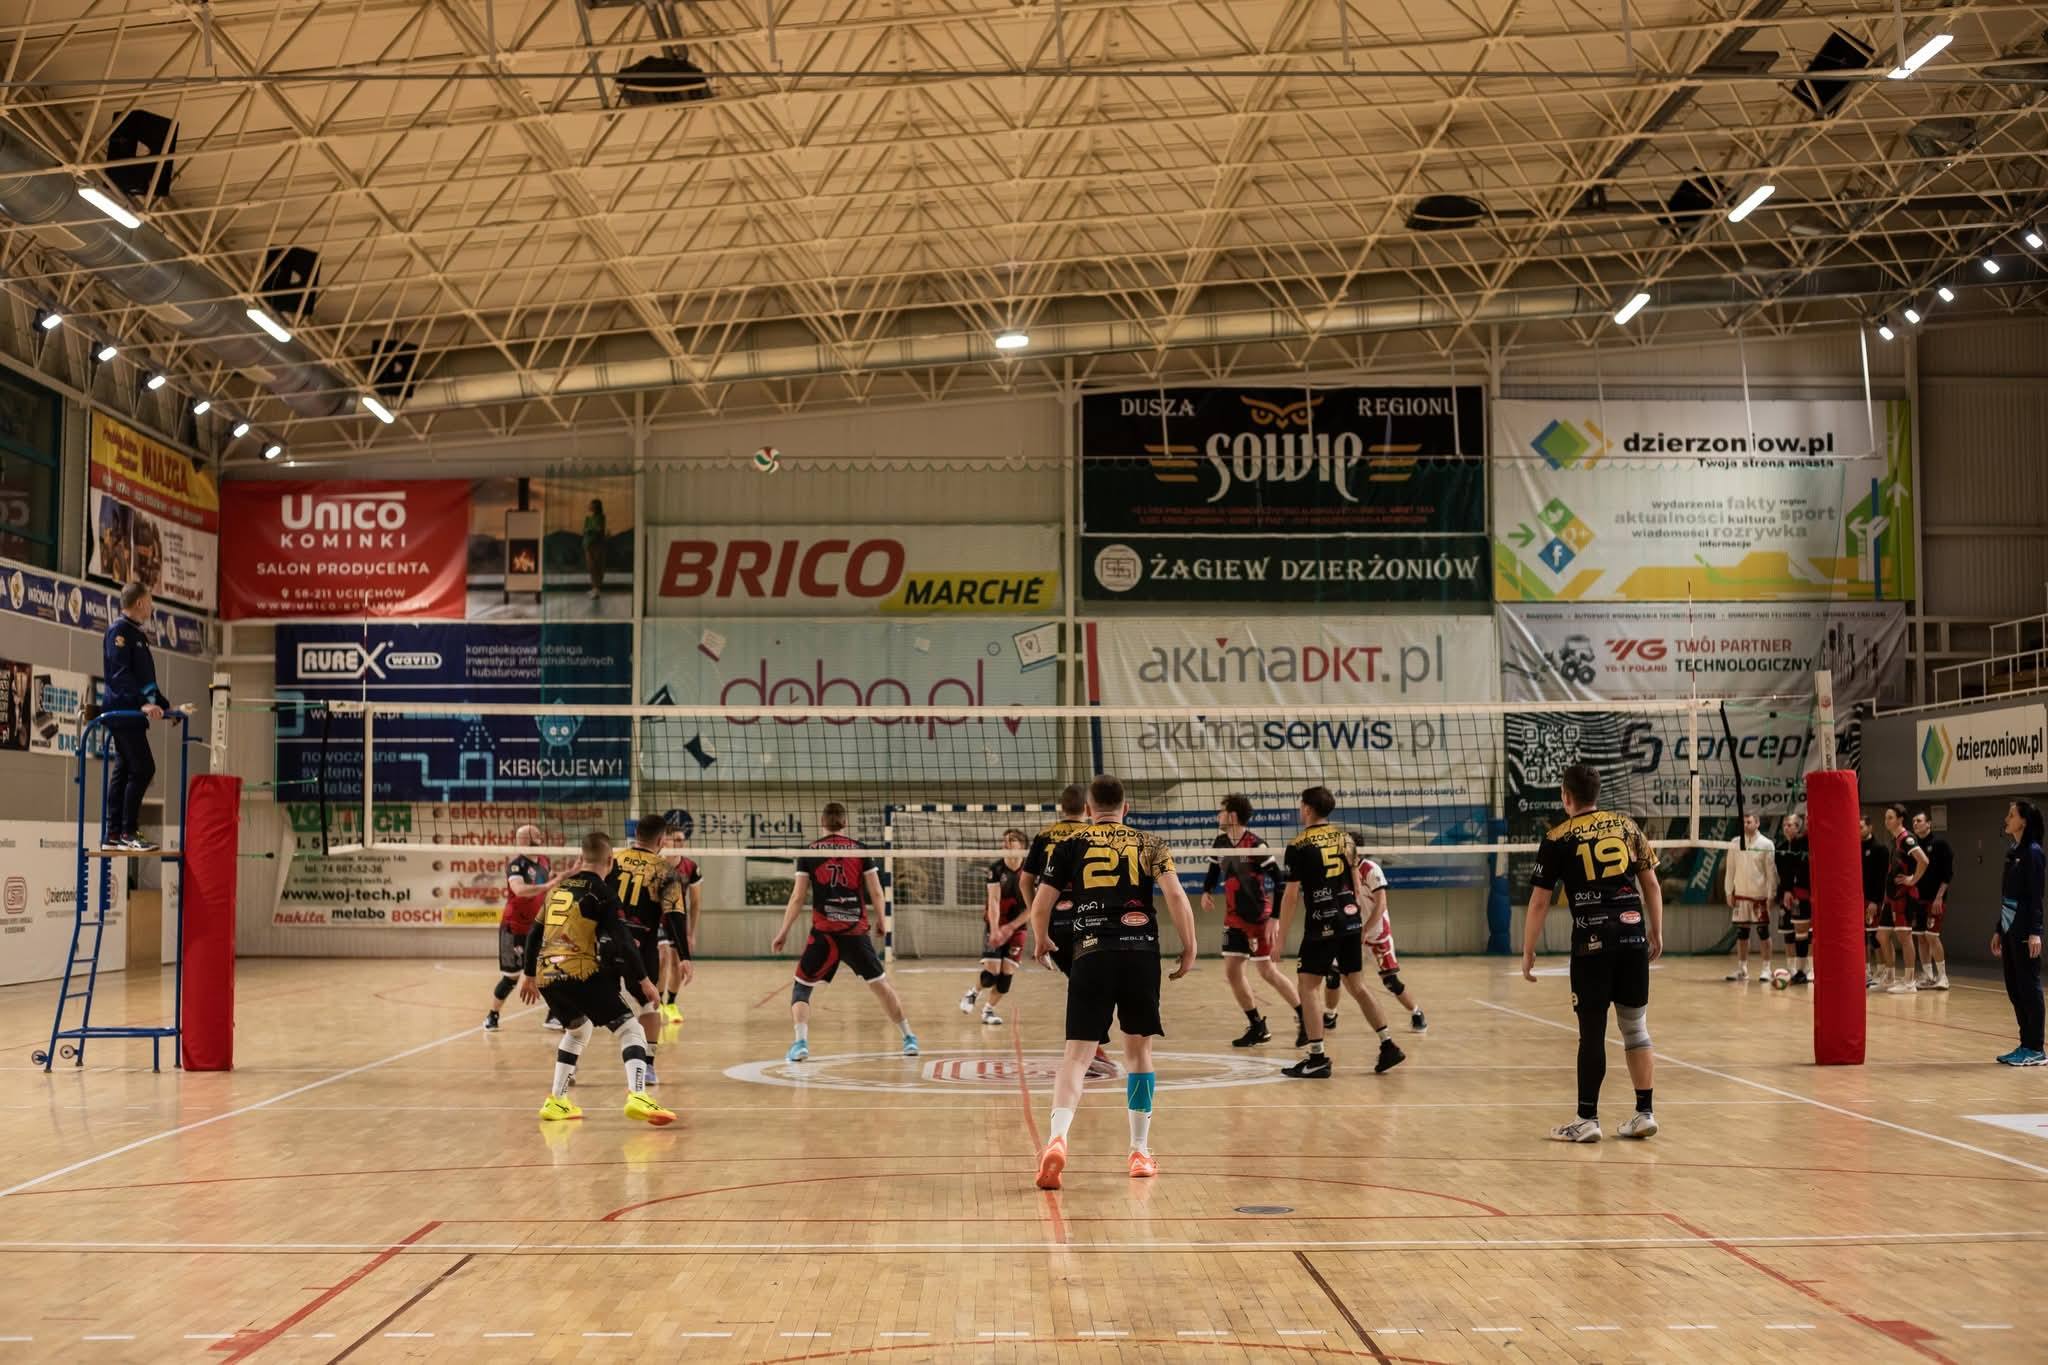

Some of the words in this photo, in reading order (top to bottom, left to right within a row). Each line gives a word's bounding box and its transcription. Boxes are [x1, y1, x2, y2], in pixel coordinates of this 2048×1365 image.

[1120, 398, 1195, 417] DUSZA
[1623, 432, 1834, 457] dzierzoniow.pl
[1727, 496, 1777, 512] fakty
[1727, 514, 1776, 525] kultura
[1780, 506, 1836, 523] sport
[280, 533, 406, 548] KOMINKI
[1712, 524, 1808, 541] rozrywka
[256, 562, 311, 576] SALON
[316, 560, 431, 576] PRODUCENTA
[658, 538, 906, 599] BRICO
[1150, 552, 1272, 581] ŻAGIEW
[1281, 552, 1481, 581] DZIERŻONIÓW
[904, 576, 1044, 605] MARCHÉ
[1674, 635, 1716, 654] TWÓJ
[1721, 638, 1792, 652] PARTNER
[1674, 657, 1814, 672] TECHNOLOGICZNY
[720, 658, 984, 741] doba.pl
[1956, 727, 2044, 761] dzierzoniow.pl
[498, 758, 623, 777] KIBICUJEMY!
[1985, 765, 2000, 780] Twoja
[2002, 764, 2021, 776] strona
[2022, 763, 2044, 775] miasta
[1652, 790, 1682, 805] dla
[1083, 845, 1140, 889] 21
[1321, 845, 1346, 879] 5
[1576, 837, 1630, 881] 19
[617, 872, 646, 906] 11
[331, 906, 386, 920] metabo
[391, 909, 442, 923] BOSCH
[545, 890, 575, 927] 2
